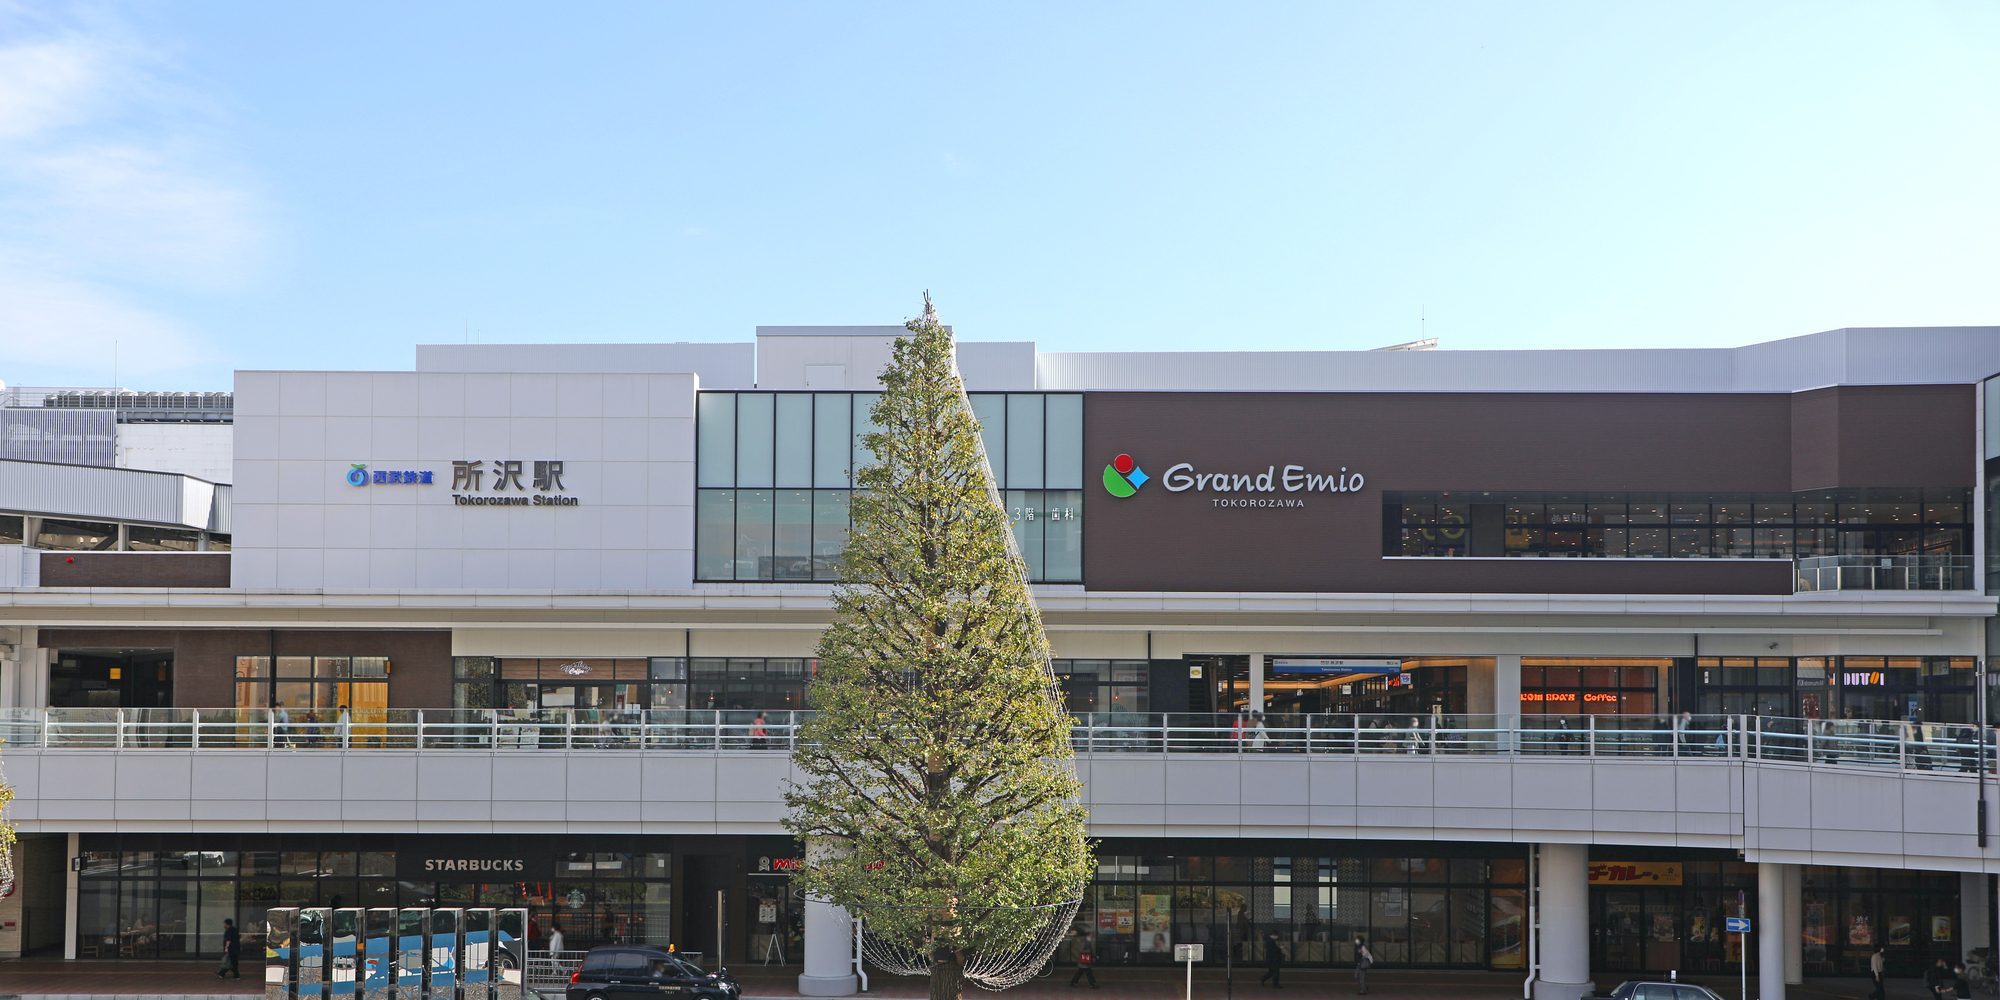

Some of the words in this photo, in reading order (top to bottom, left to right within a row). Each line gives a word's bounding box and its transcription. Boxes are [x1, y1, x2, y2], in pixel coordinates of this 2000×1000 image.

[451, 460, 565, 492] 所沢駅
[1162, 462, 1275, 493] Grand
[1281, 464, 1364, 493] Emio
[452, 494, 529, 506] Tokorozawa
[532, 494, 578, 506] Station
[1212, 499, 1305, 508] TOKOROZAWA
[1013, 507, 1035, 521] 3階
[1051, 507, 1075, 521] 歯科
[1583, 693, 1617, 702] Coffee
[425, 859, 524, 871] STARBUCKS
